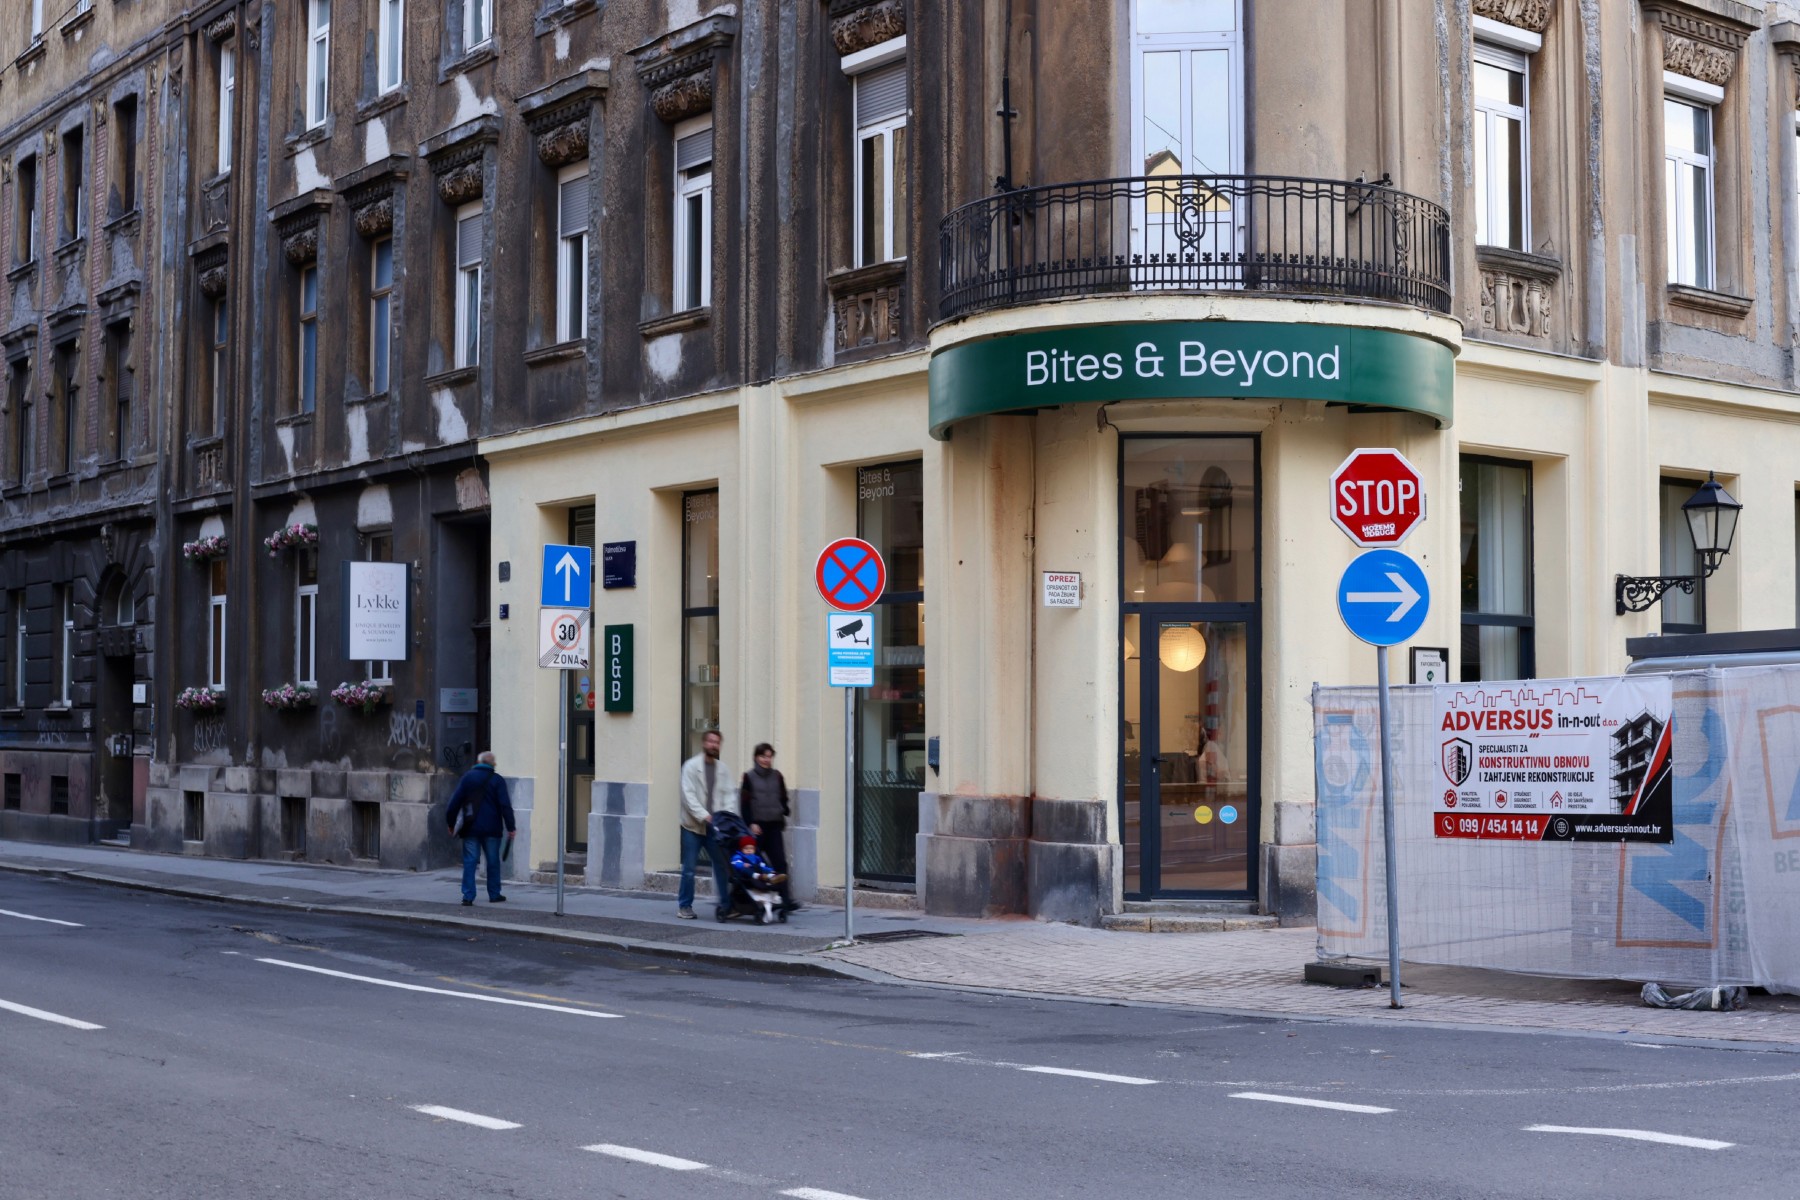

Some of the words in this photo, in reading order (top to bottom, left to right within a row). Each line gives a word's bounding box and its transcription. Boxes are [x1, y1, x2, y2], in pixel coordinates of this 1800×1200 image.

[1027, 348, 1123, 386] Bites
[1135, 342, 1164, 378] &
[1180, 341, 1339, 387] Beyond
[859, 470, 882, 485] Bites
[883, 468, 891, 482] &
[859, 484, 894, 502] Beyond
[1339, 479, 1416, 516] STOP
[686, 496, 704, 508] Bites
[686, 508, 714, 524] Beyond
[357, 594, 400, 613] Lykke
[558, 624, 576, 641] 30
[553, 653, 580, 665] ZONA
[1441, 708, 1554, 731] ADVERSUS
[1558, 713, 1600, 728] in-n-out
[1602, 718, 1618, 727] d.o.o.
[1478, 745, 1518, 753] SPECIJALISTI
[1519, 745, 1528, 753] ZA
[1478, 756, 1551, 769] KONSTRUKTIVNU
[1553, 756, 1590, 769] OBNOVU
[1484, 772, 1526, 782] ZAHTJEVNE
[1528, 772, 1595, 782] REKONSTRUKCIJE
[1460, 818, 1479, 833] 099
[1481, 818, 1486, 834] /
[1487, 819, 1508, 833] 454
[1511, 820, 1523, 834] 14
[1526, 820, 1538, 834] 14
[1575, 823, 1661, 835] www.adversusinnout.hr
